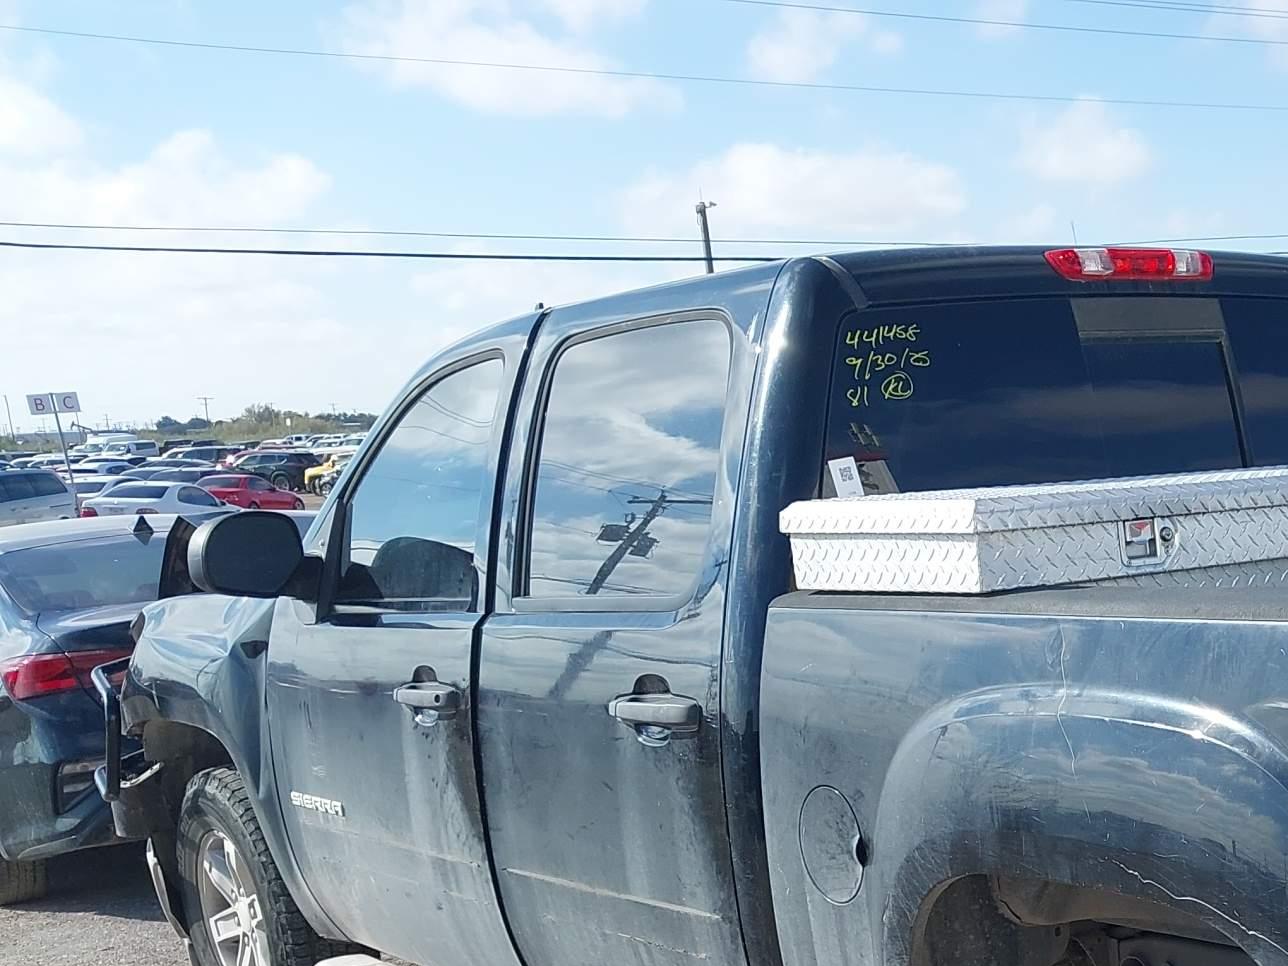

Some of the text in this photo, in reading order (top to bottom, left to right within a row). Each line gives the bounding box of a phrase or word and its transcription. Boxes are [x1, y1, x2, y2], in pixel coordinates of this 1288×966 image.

[33, 397, 46, 411] B
[62, 395, 75, 409] C
[290, 790, 346, 817] SIERRA
